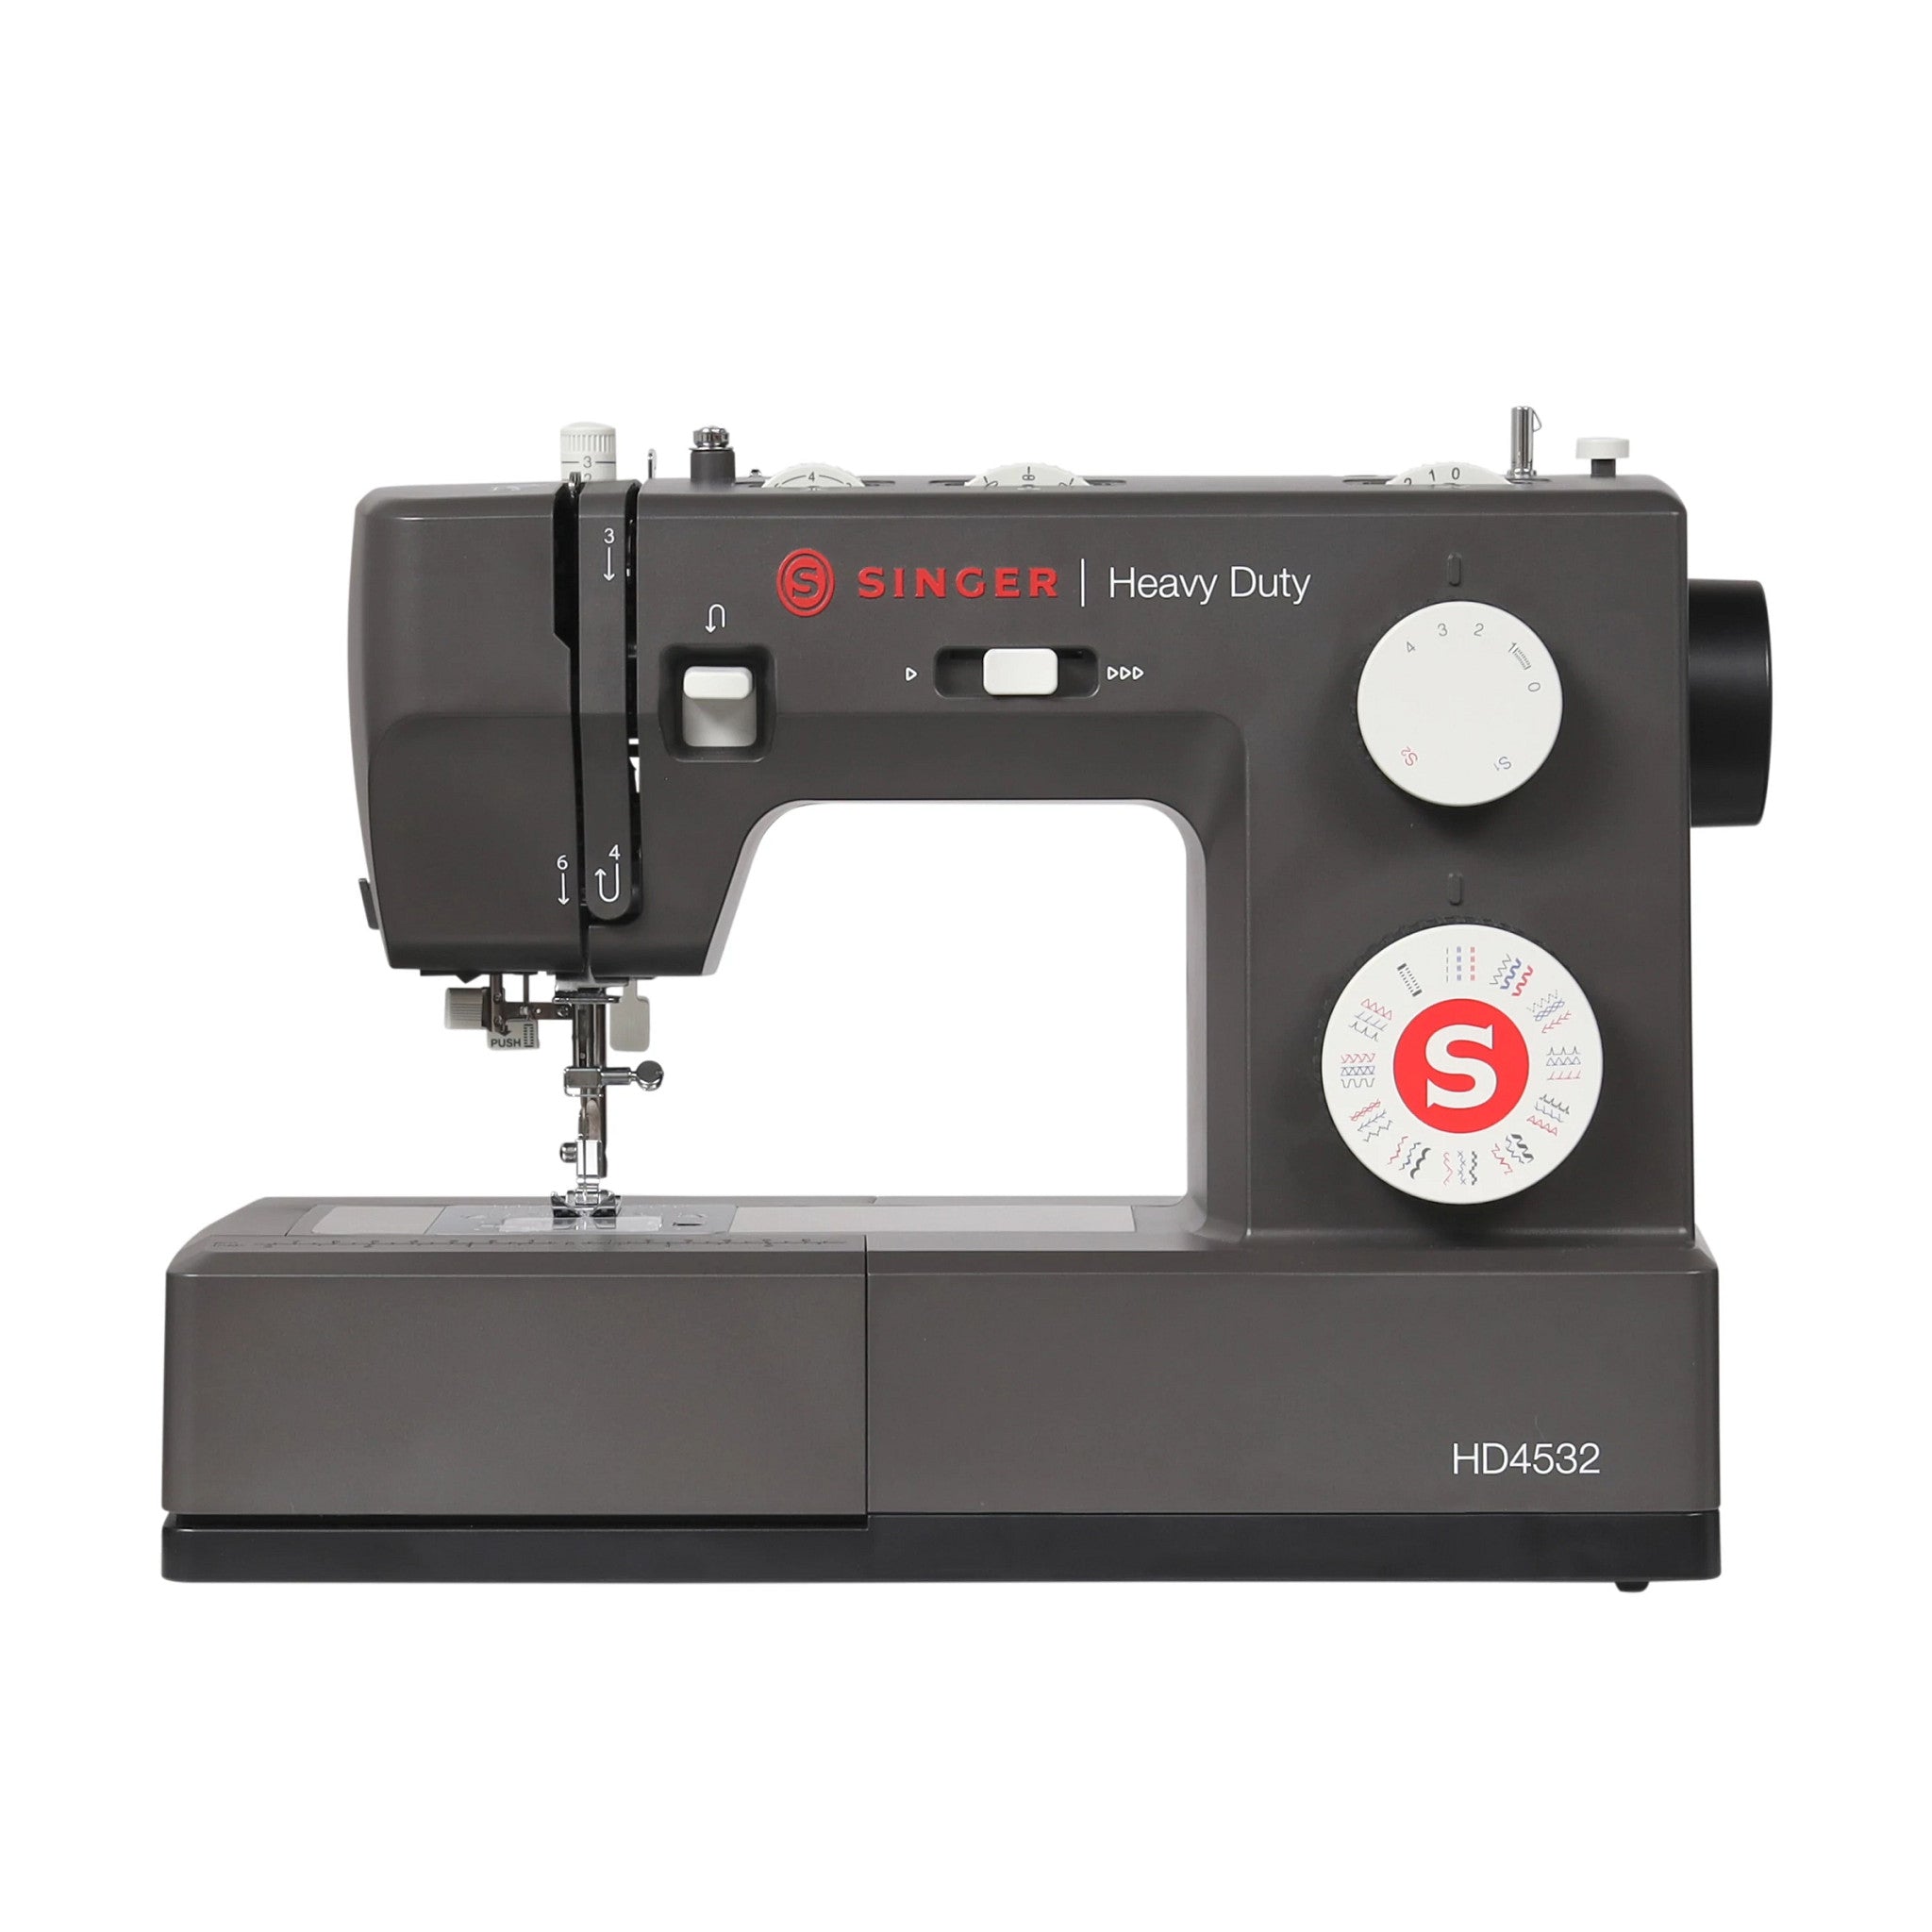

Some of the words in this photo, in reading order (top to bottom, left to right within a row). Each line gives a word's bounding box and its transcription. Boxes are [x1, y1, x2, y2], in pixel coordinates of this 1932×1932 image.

[583, 456, 591, 468] 3
[808, 472, 815, 482] 4
[1428, 469, 1435, 482] 1
[1451, 467, 1460, 480] 0
[603, 527, 615, 543] 3
[858, 566, 1058, 599] SINGER
[1109, 566, 1218, 606] Heavy
[1230, 566, 1311, 606] Duty
[1406, 641, 1416, 653] 4
[1437, 623, 1448, 637] 3
[1473, 623, 1485, 637] 2
[1527, 681, 1541, 692] 0
[608, 843, 621, 860] 4
[557, 855, 568, 871] 6
[490, 1038, 522, 1048] PUSH
[1424, 1023, 1499, 1109] S
[1453, 1442, 1601, 1475] HD4532
